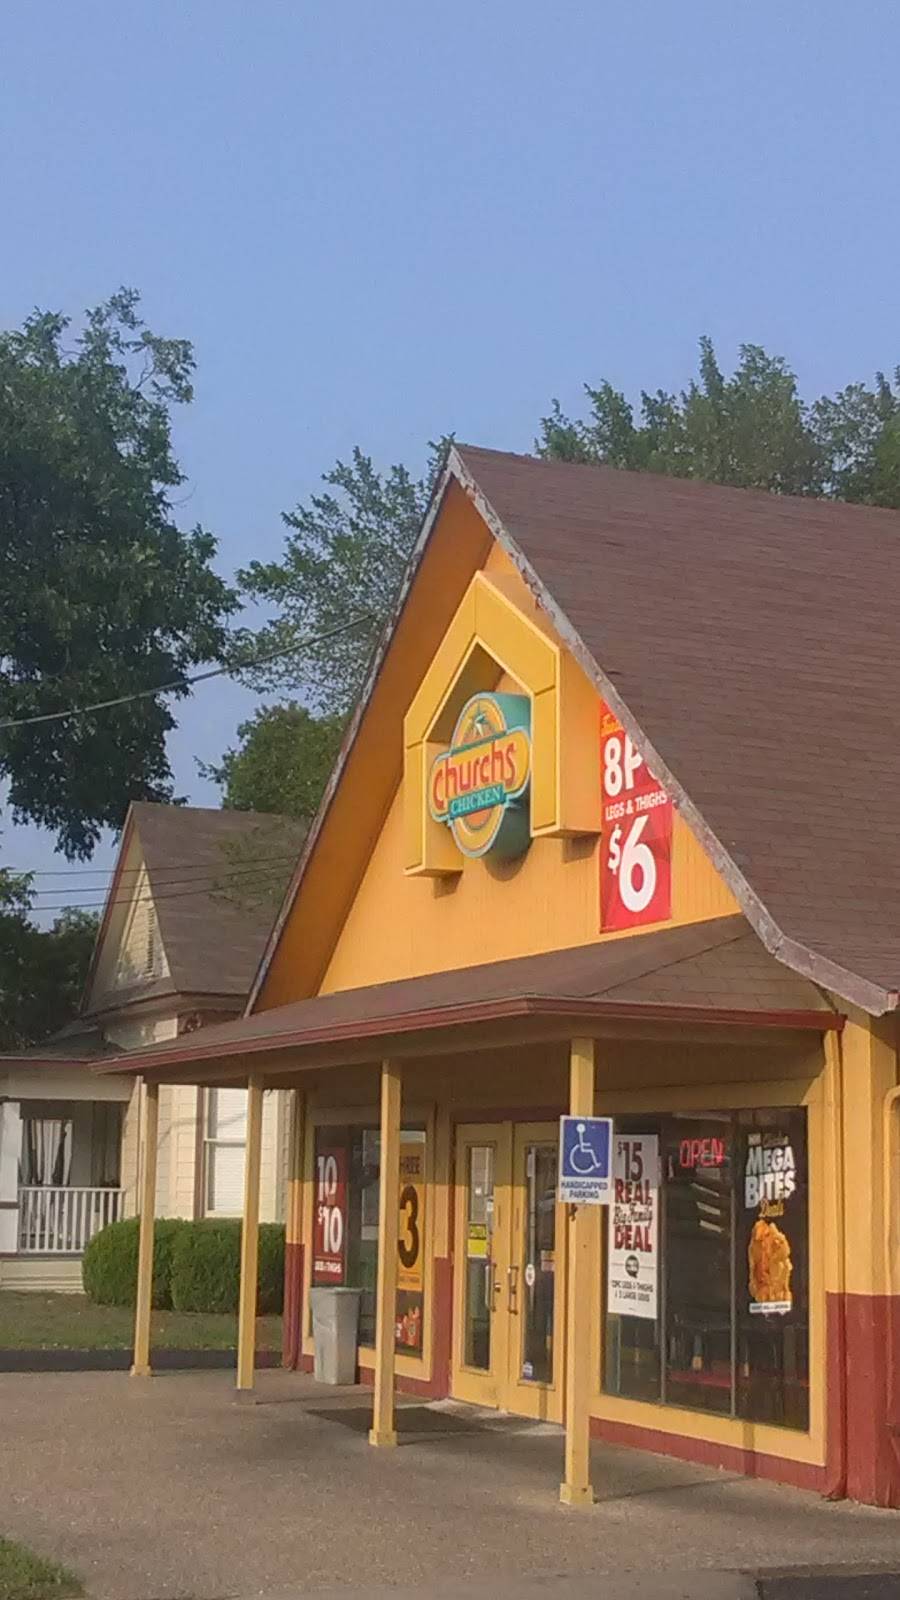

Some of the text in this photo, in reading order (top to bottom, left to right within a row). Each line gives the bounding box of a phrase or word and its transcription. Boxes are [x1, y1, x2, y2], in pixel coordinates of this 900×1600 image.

[604, 733, 656, 797] 8P
[450, 785, 502, 814] CHICKEN
[605, 790, 668, 821] LEGS & THIGHS
[607, 815, 657, 913] $6
[617, 1142, 644, 1182] $15
[679, 1137, 726, 1168] OPEN
[746, 1146, 796, 1175] MEGA
[317, 1156, 337, 1201] 10
[560, 1181, 608, 1190] HANDICAPPED
[615, 1178, 653, 1206] REAL
[745, 1170, 798, 1209] BITES
[569, 1190, 600, 1199] PARKING
[318, 1206, 342, 1253] $10
[614, 1224, 653, 1252] DEAL
